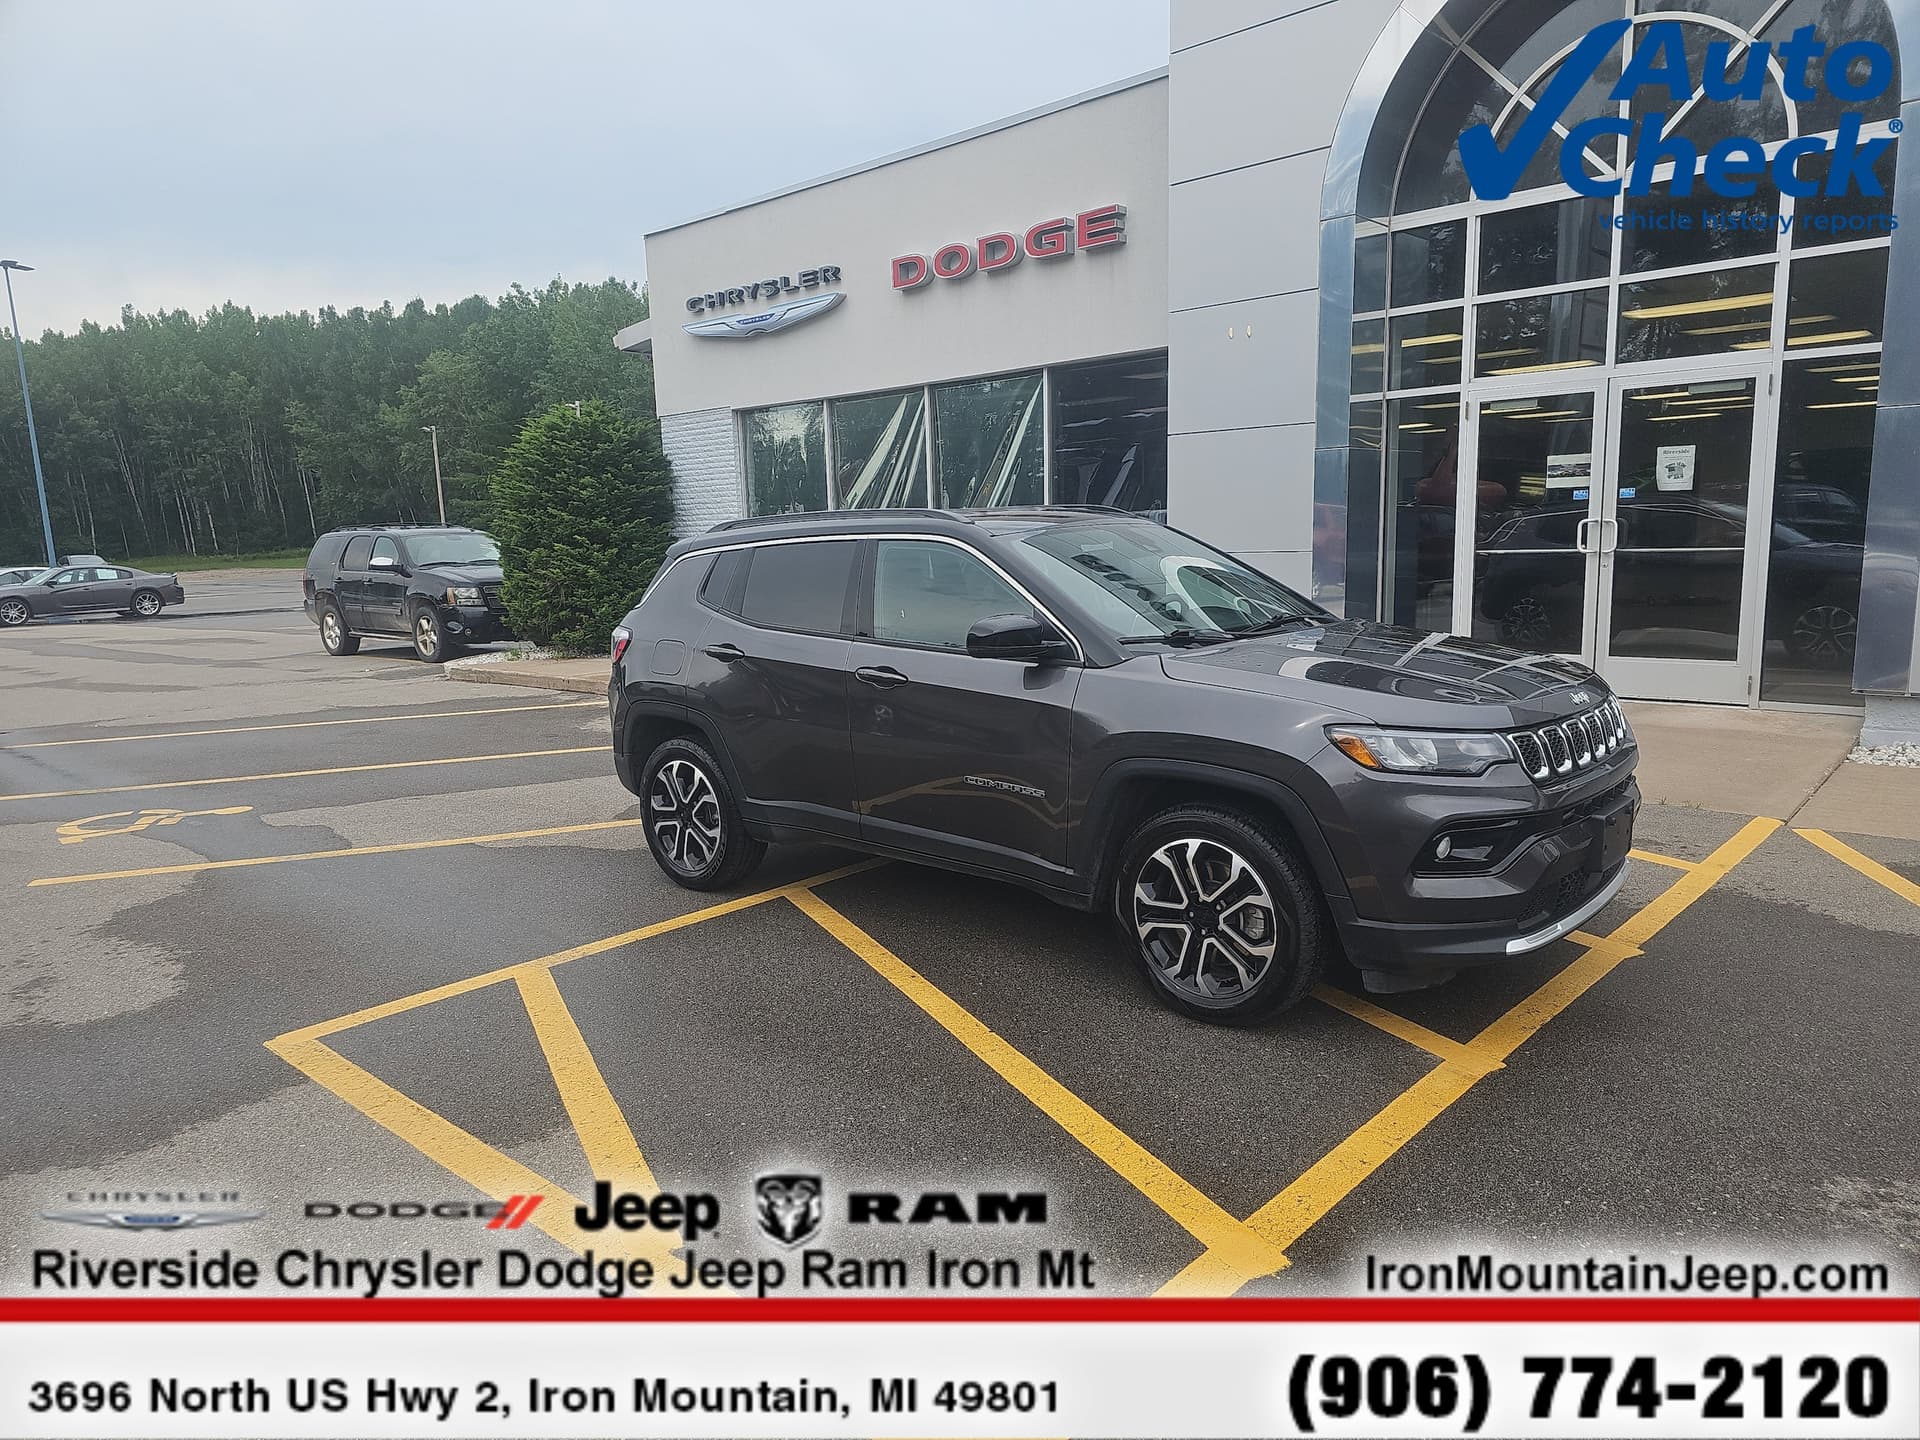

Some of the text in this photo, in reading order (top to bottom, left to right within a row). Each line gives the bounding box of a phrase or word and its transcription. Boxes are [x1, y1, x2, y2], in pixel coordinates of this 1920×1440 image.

[890, 203, 1127, 291] DODGE
[686, 265, 841, 314] CHRYSLER
[963, 775, 1047, 798] COMPASS
